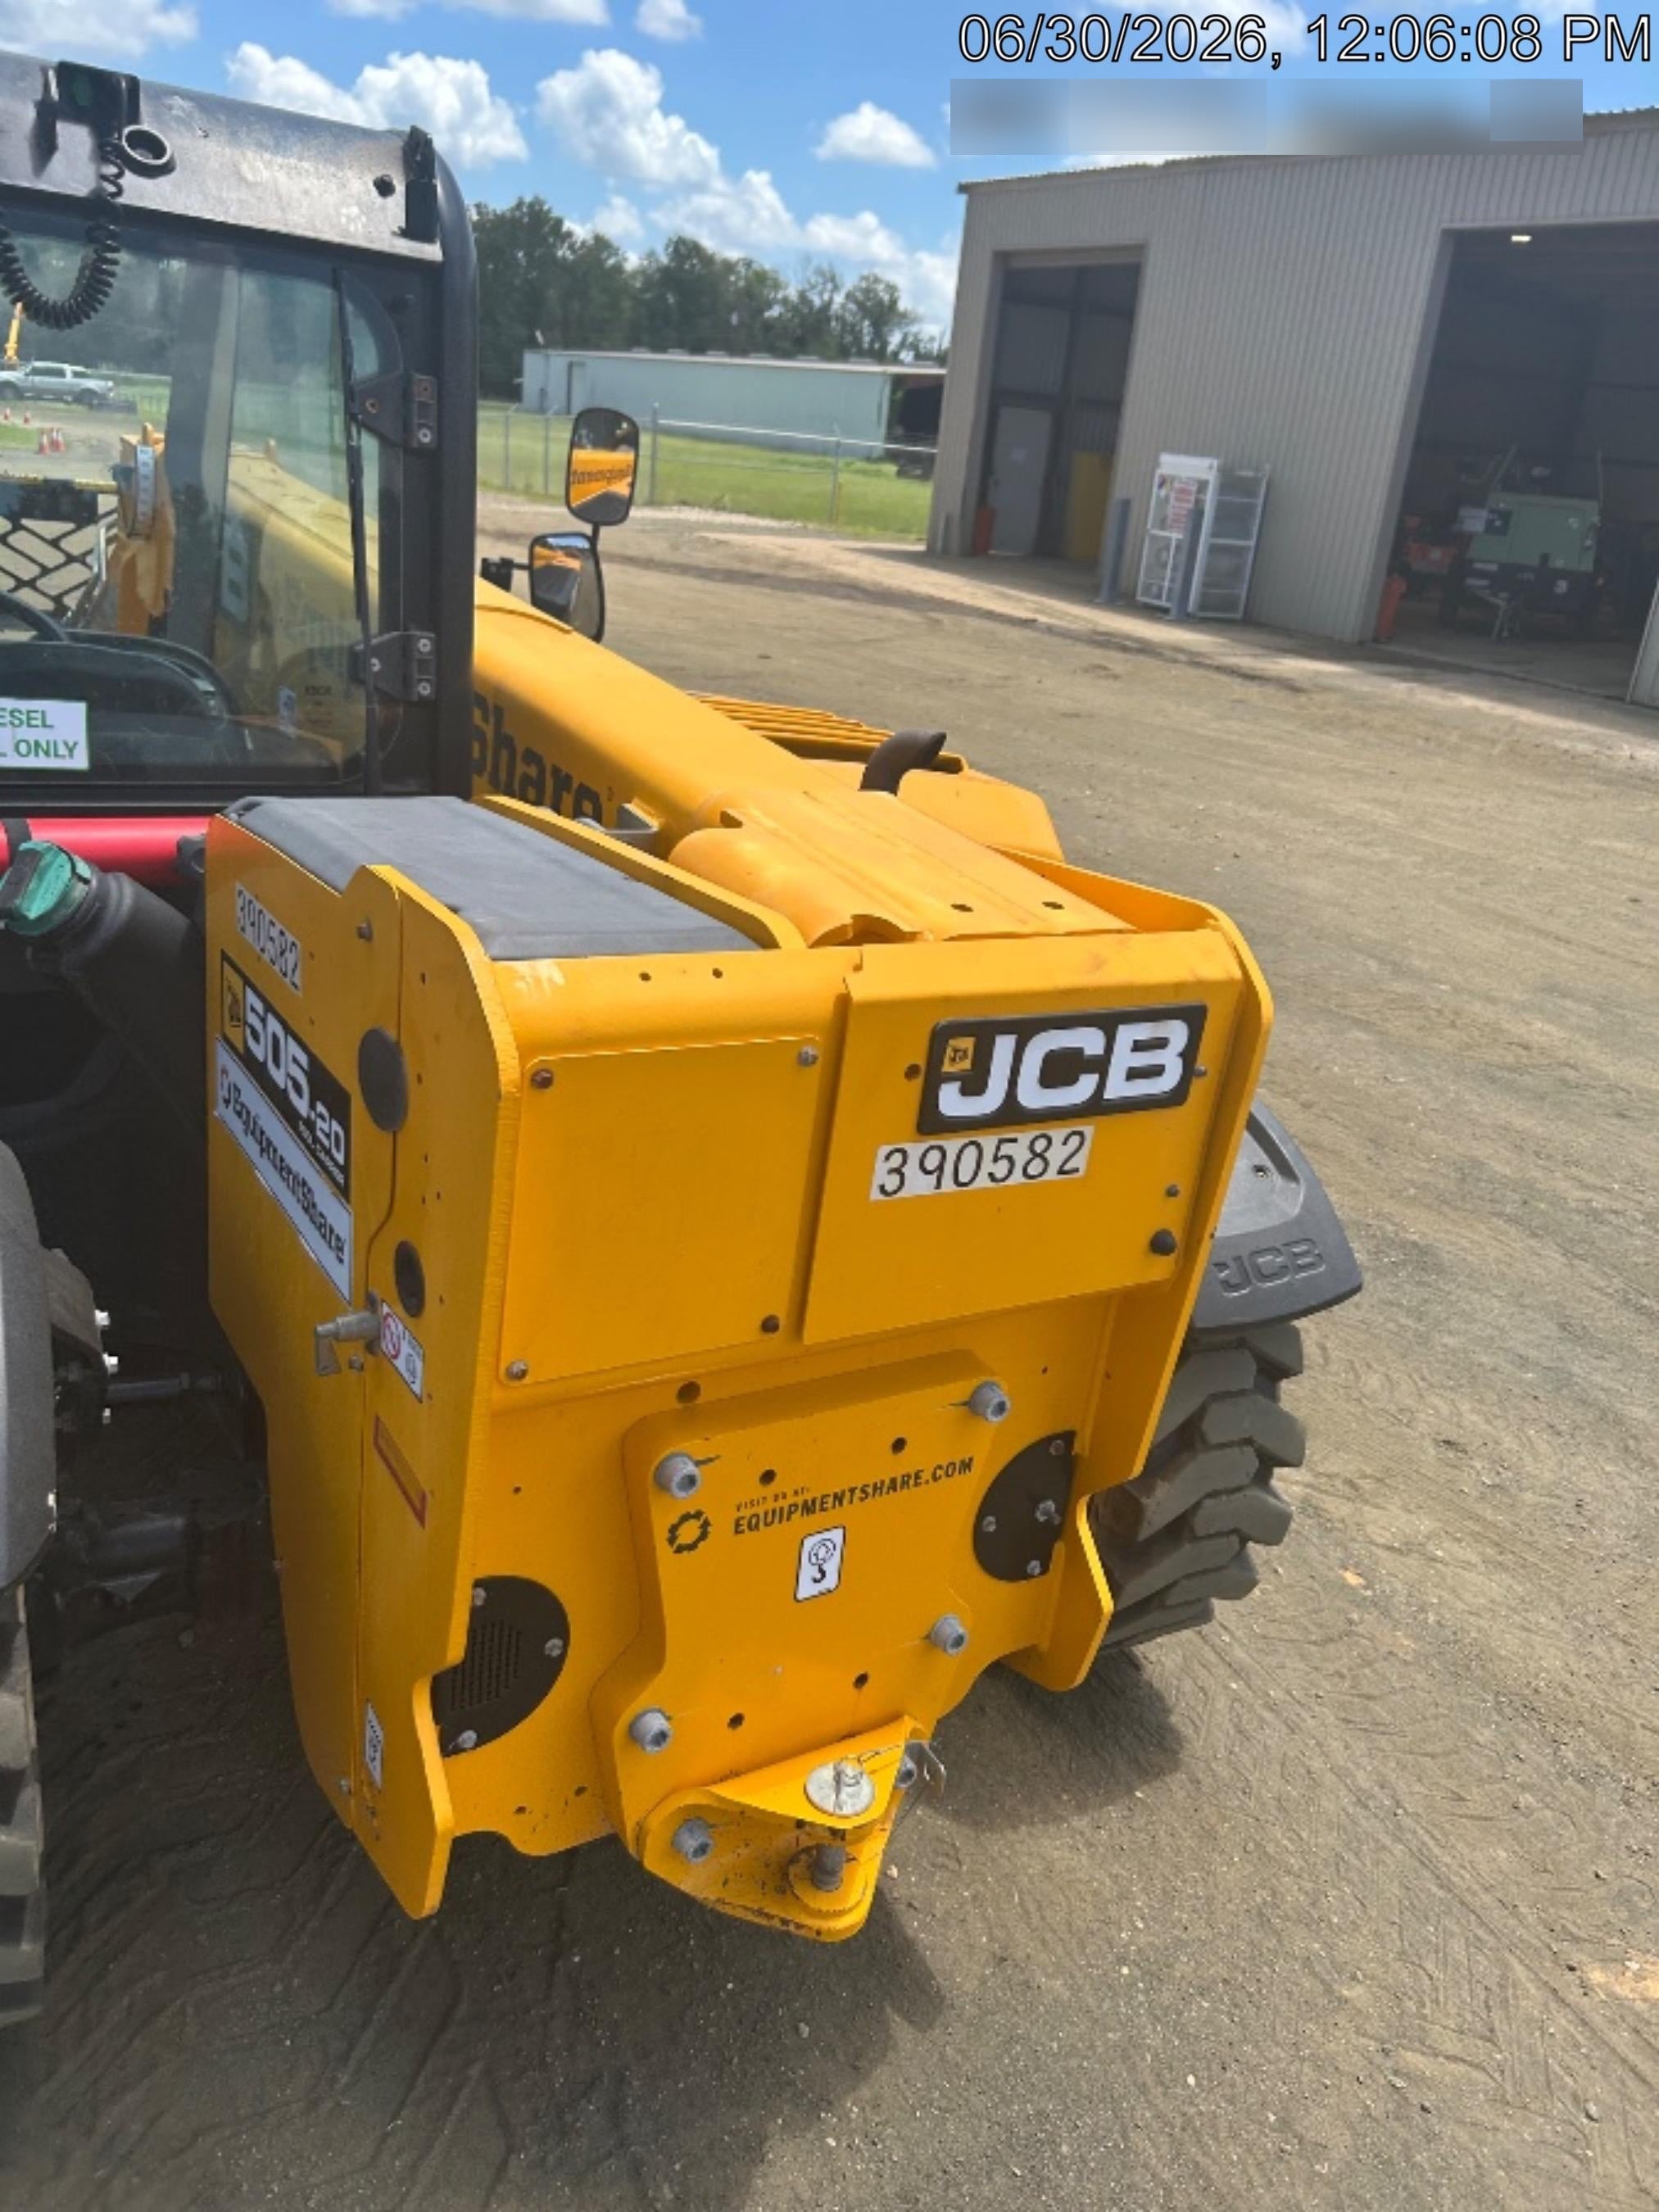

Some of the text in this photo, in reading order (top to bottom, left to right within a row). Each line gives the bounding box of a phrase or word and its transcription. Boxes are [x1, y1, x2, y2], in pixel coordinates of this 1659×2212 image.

[14, 739, 79, 759] ONLY
[238, 889, 300, 990] 390582
[938, 1018, 1190, 1117] JCB
[878, 1130, 1086, 1197] 390582
[1212, 1238, 1326, 1298] JCB
[734, 1456, 975, 1535] EQUIPMENTSHARE.COM
